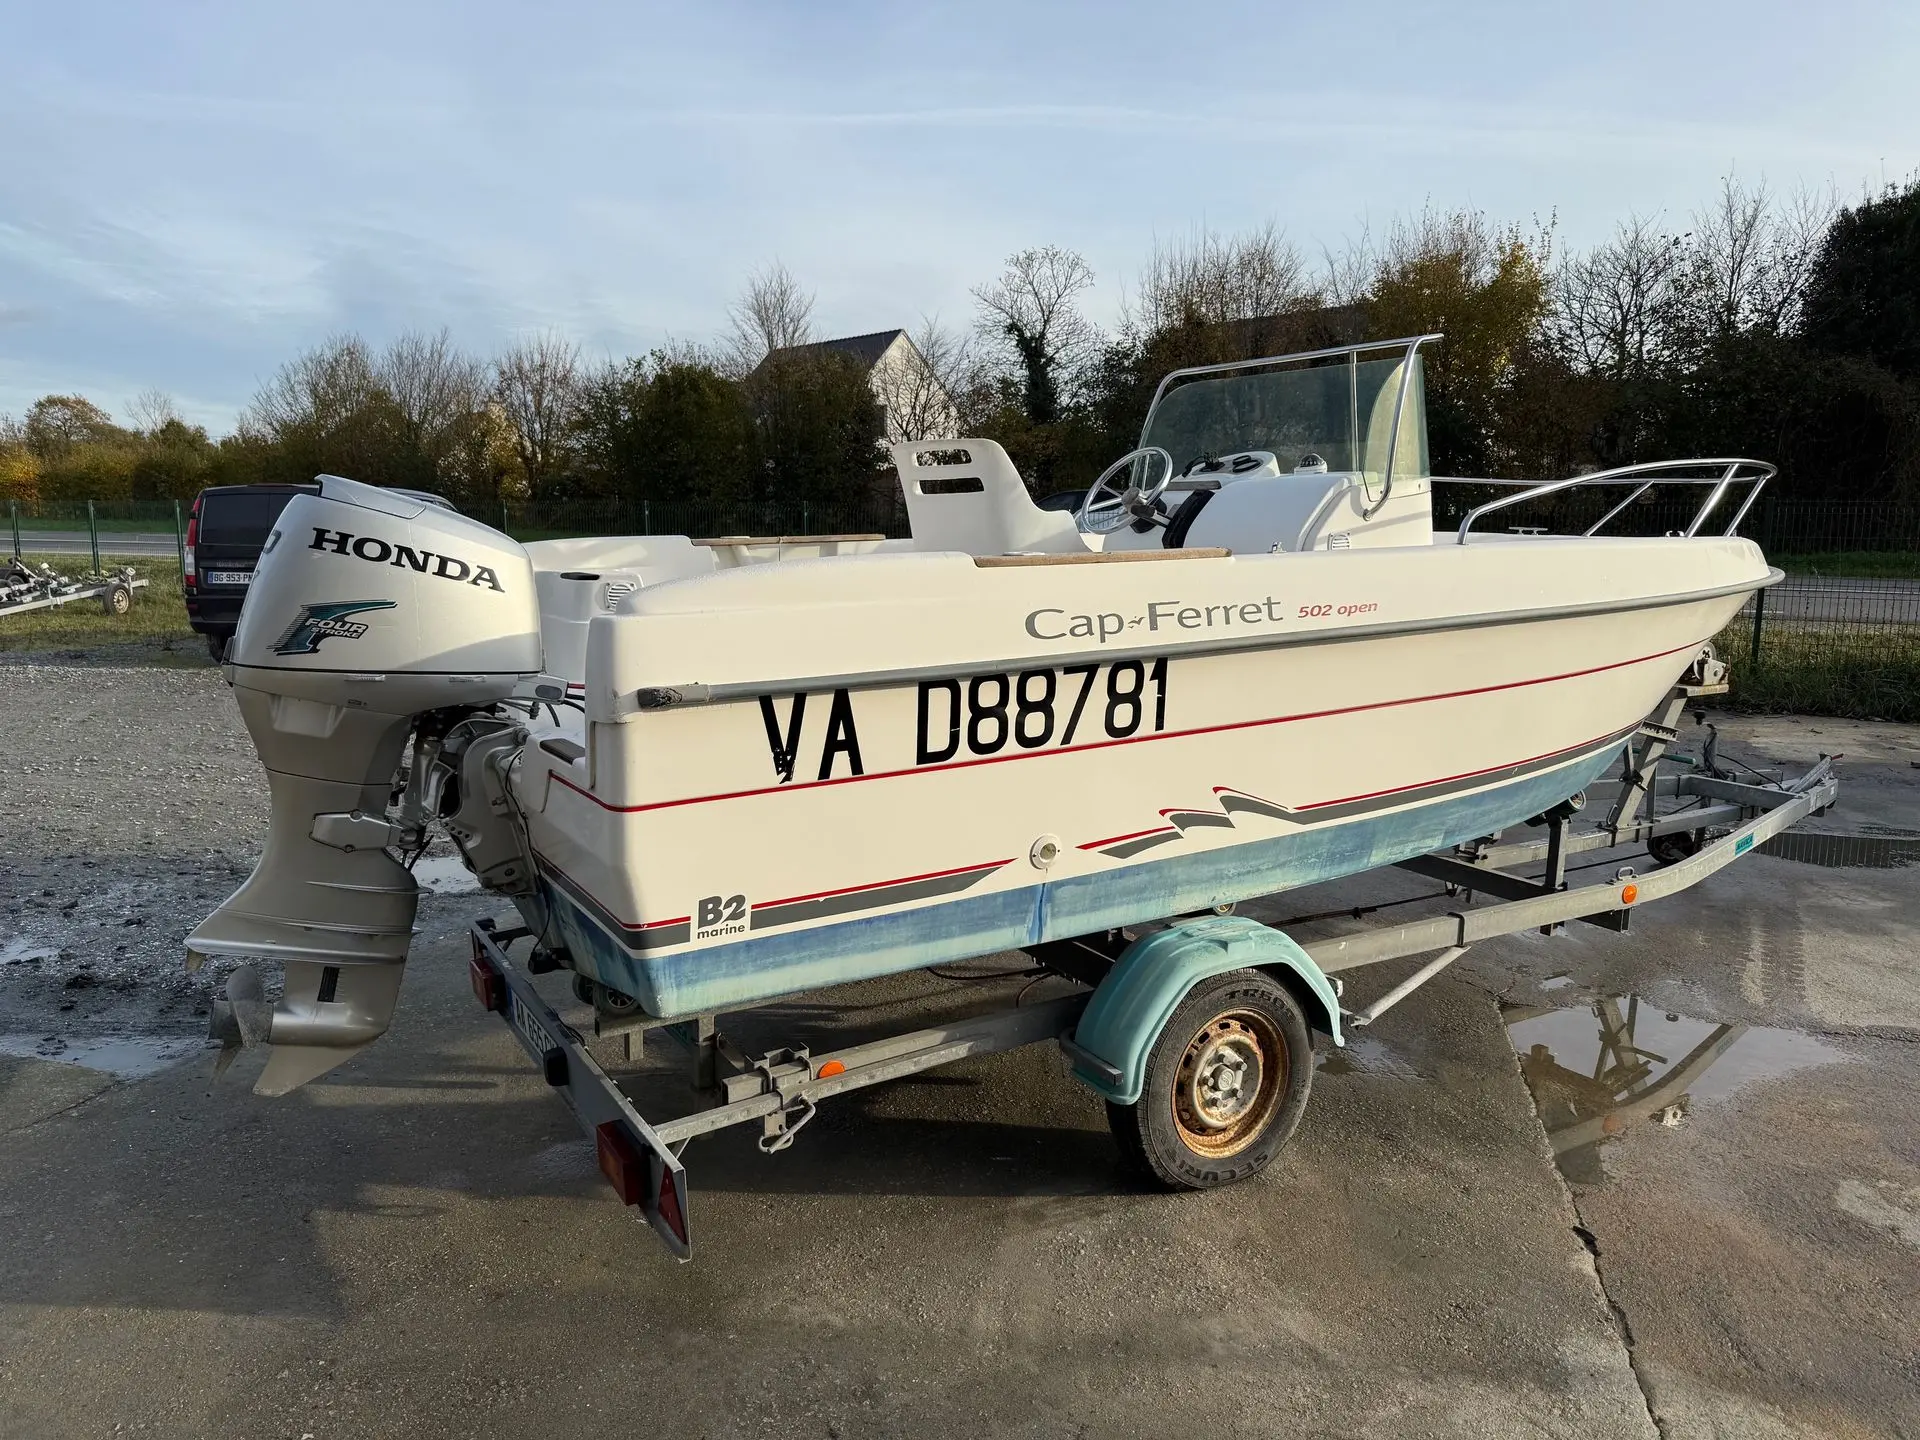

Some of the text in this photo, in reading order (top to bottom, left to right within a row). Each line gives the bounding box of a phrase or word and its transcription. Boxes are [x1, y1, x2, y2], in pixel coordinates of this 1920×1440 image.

[308, 527, 505, 593] HONDA
[1297, 602, 1378, 618] 502 open
[305, 618, 367, 633] FOUR
[311, 627, 361, 638] STROKE
[916, 657, 1168, 766] D88781
[698, 894, 746, 929] B2
[697, 922, 746, 939] marine
